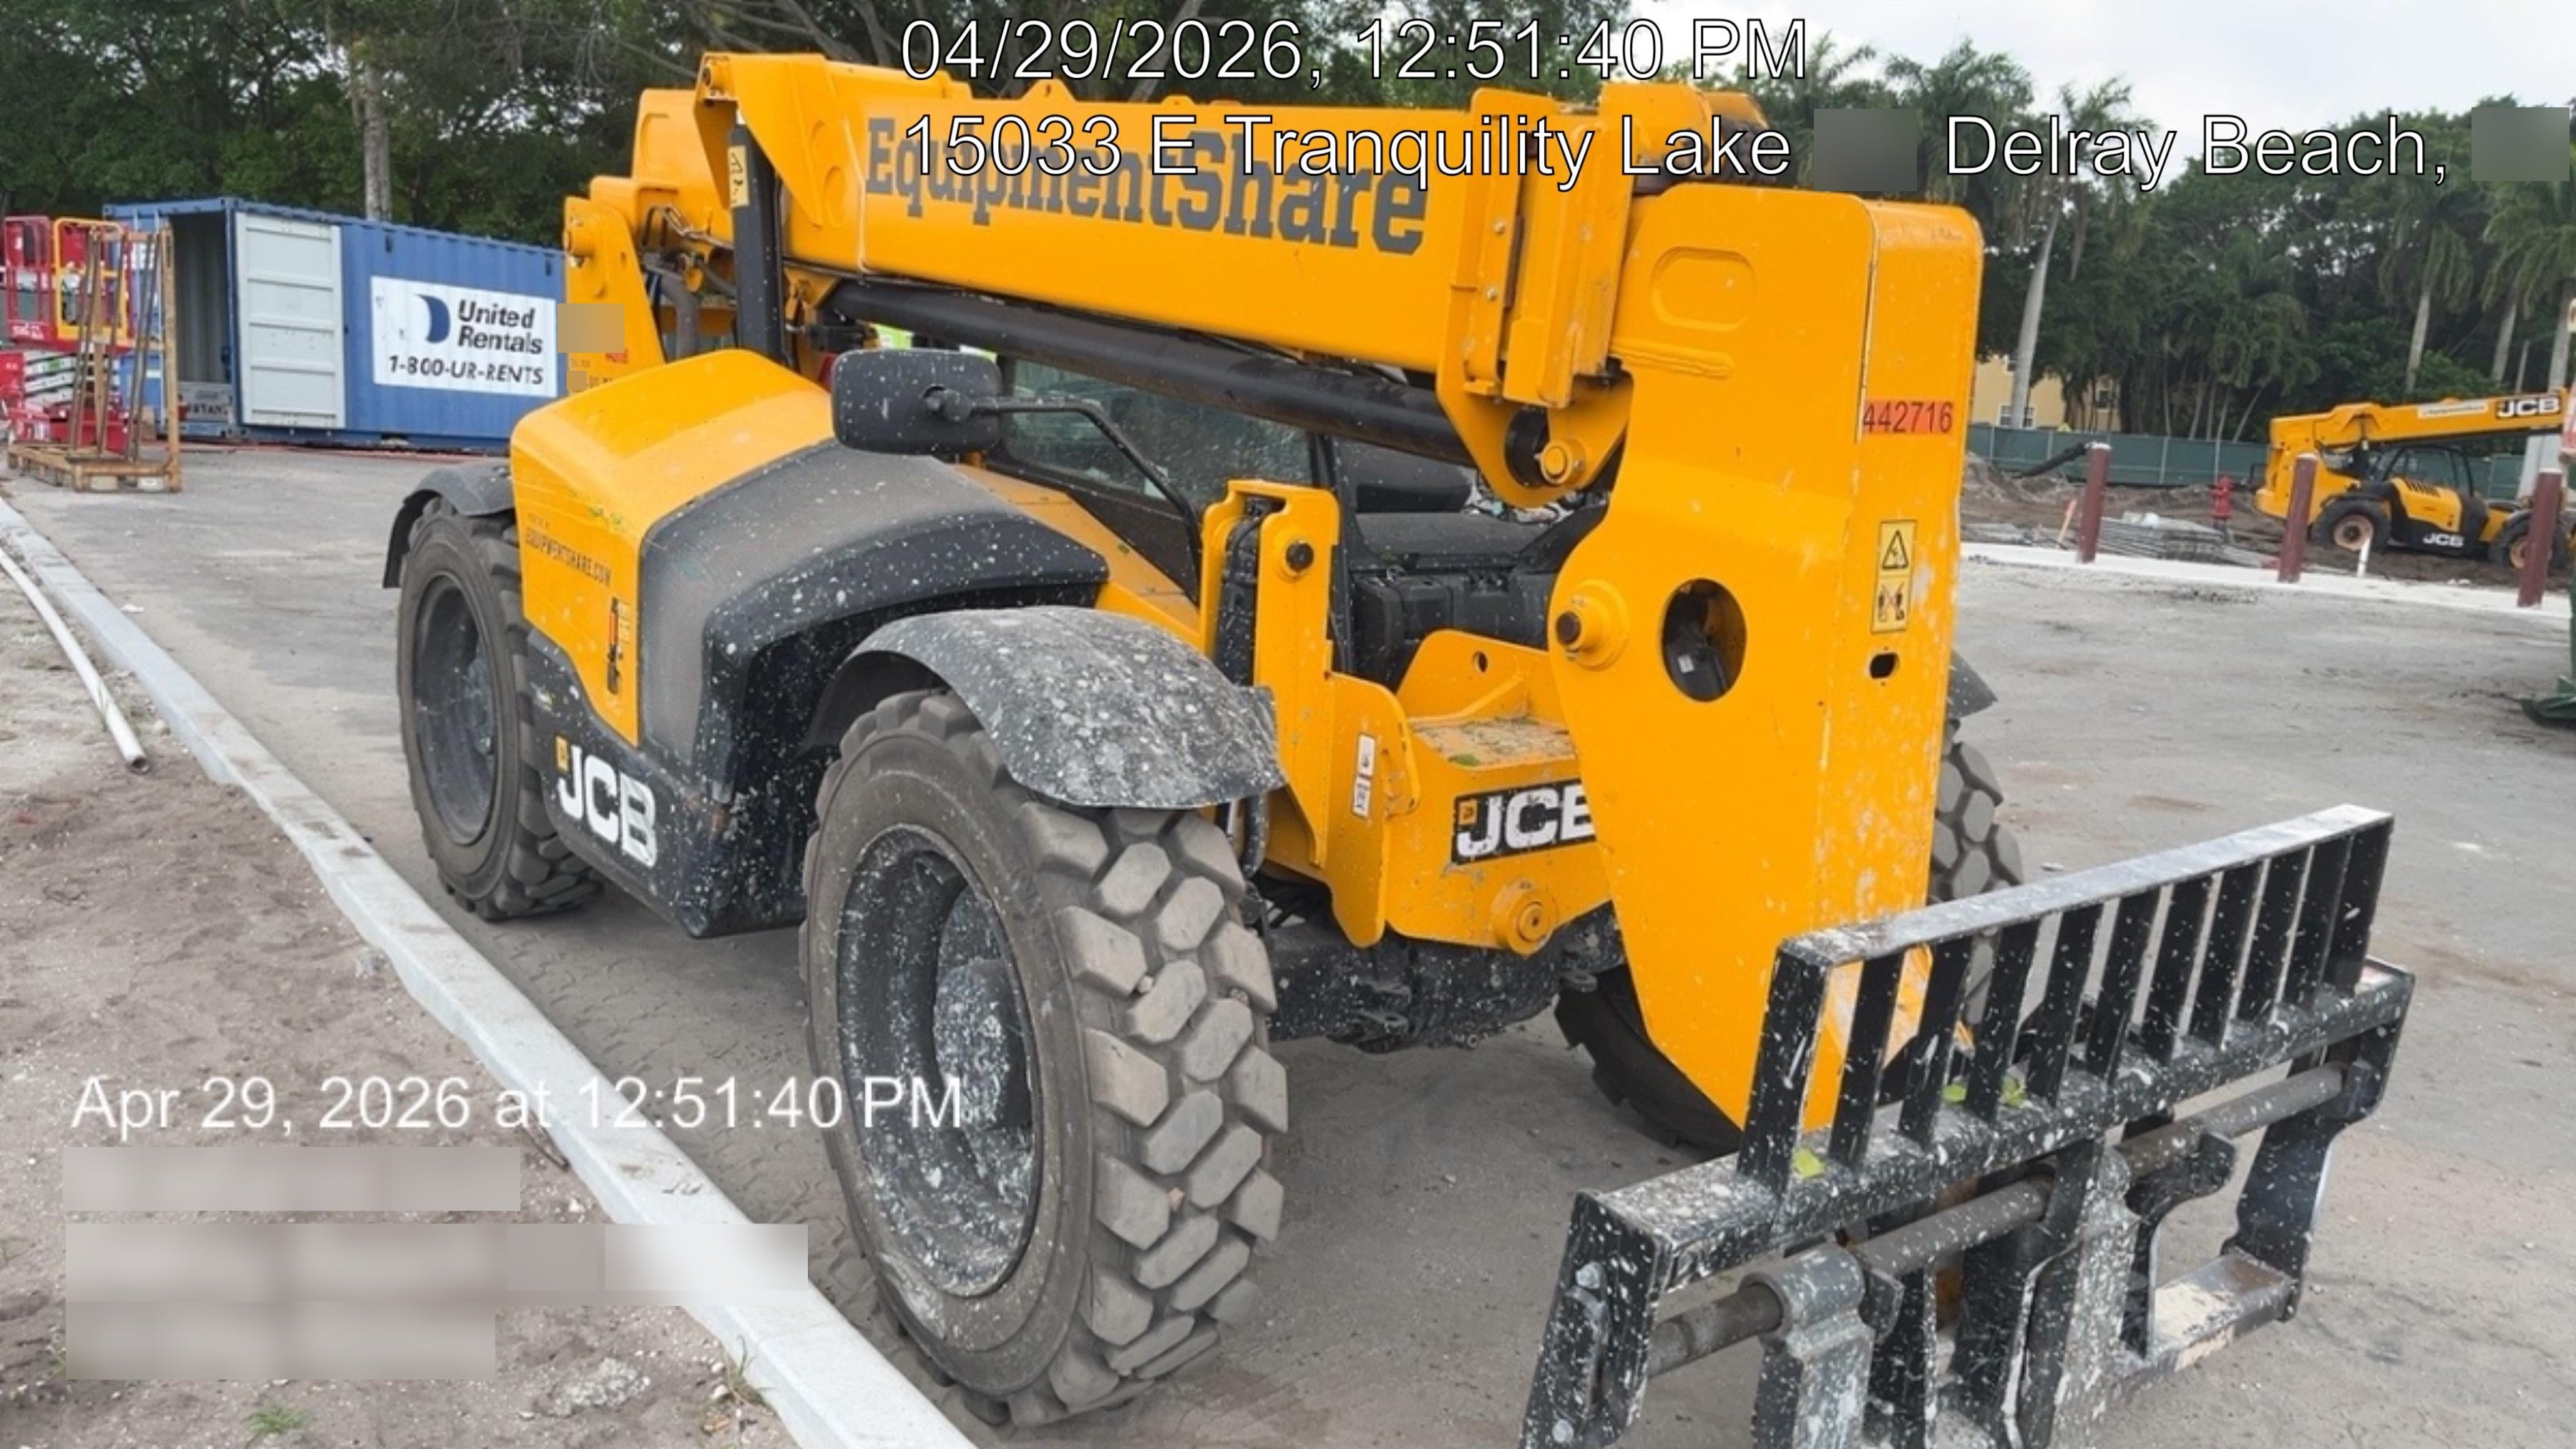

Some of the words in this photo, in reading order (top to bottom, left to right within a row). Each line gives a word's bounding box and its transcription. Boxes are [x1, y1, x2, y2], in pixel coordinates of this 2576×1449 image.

[865, 117, 1429, 255] EquipmentShare
[457, 299, 535, 329] United
[457, 326, 544, 355] Rentals
[389, 356, 545, 385] 1-800-UR-RENTS
[1862, 400, 1954, 434] 442716
[2497, 397, 2560, 418] JCB
[2423, 532, 2465, 548] JCB
[556, 743, 658, 867] JCB
